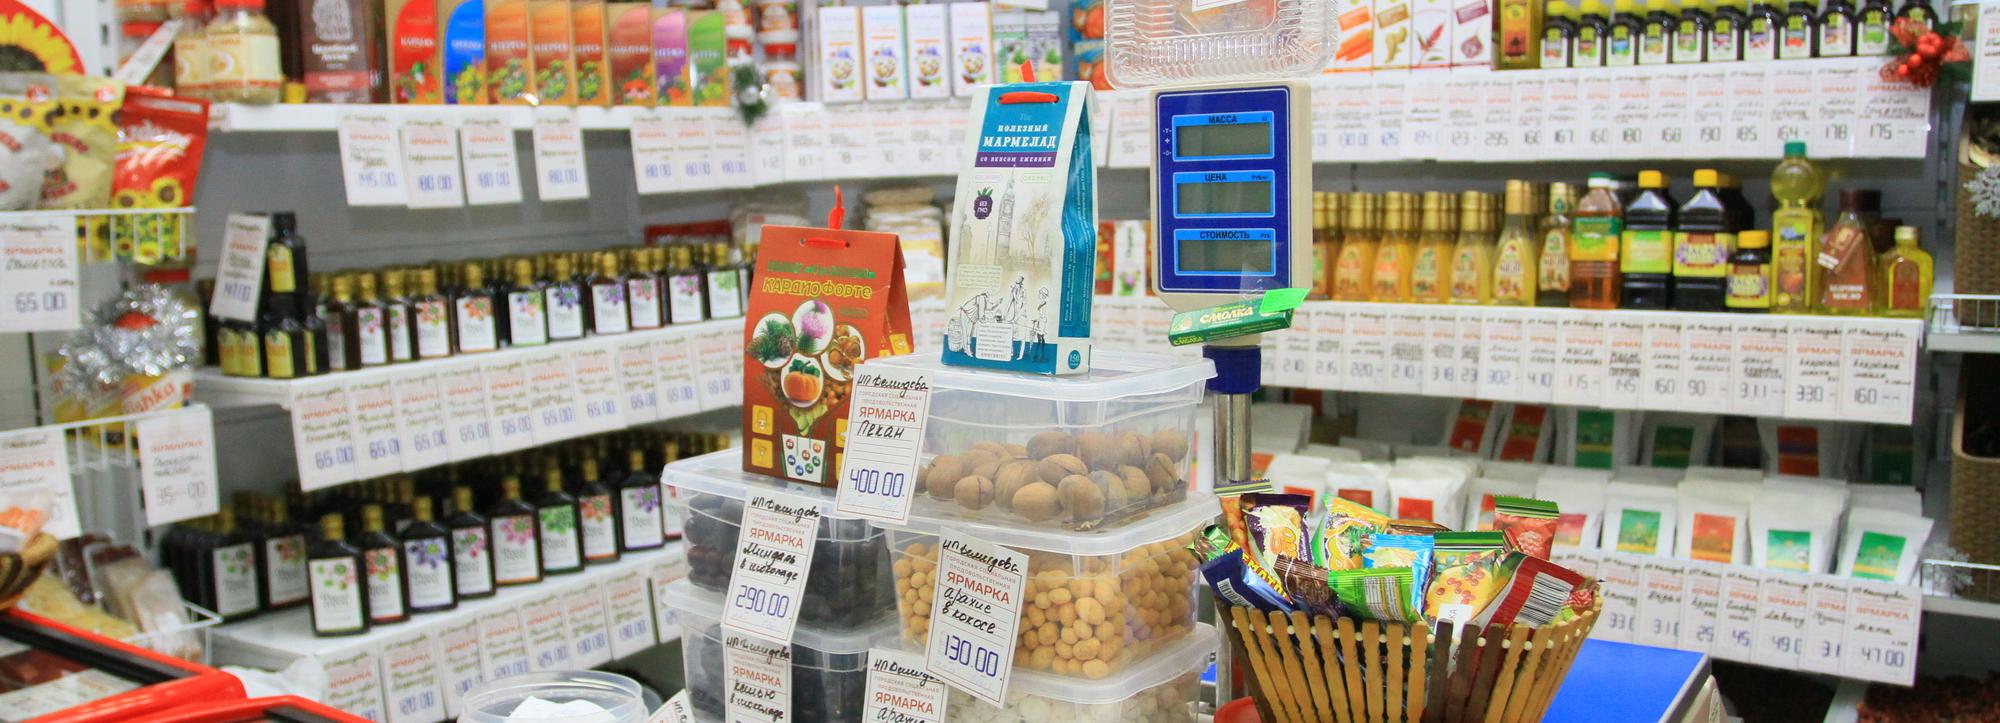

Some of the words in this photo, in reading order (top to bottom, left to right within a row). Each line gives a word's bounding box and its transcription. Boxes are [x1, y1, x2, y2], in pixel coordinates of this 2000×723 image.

[1208, 115, 1238, 124] МАССА
[998, 124, 1048, 132] ПОЛЕЗНЫЙ
[982, 135, 1057, 148] МАРМЕЛАД
[1204, 172, 1227, 182] ЦЕНА
[1200, 230, 1250, 240] СТОИМОСТЬ
[857, 374, 871, 386] ИП
[858, 406, 916, 423] ЯРМАРКА
[857, 420, 904, 439] Пекан
[751, 496, 766, 508] ИП
[750, 528, 804, 549] ЯРМАРКА
[942, 538, 960, 550] ИП
[743, 542, 796, 566] Миндаль
[947, 571, 1010, 604] ЯРМАРКА
[952, 607, 997, 634] кокосе
[874, 658, 888, 671] ИП
[732, 666, 782, 689] ЯРМАРКА
[875, 690, 934, 716] ЯРМАРКА
